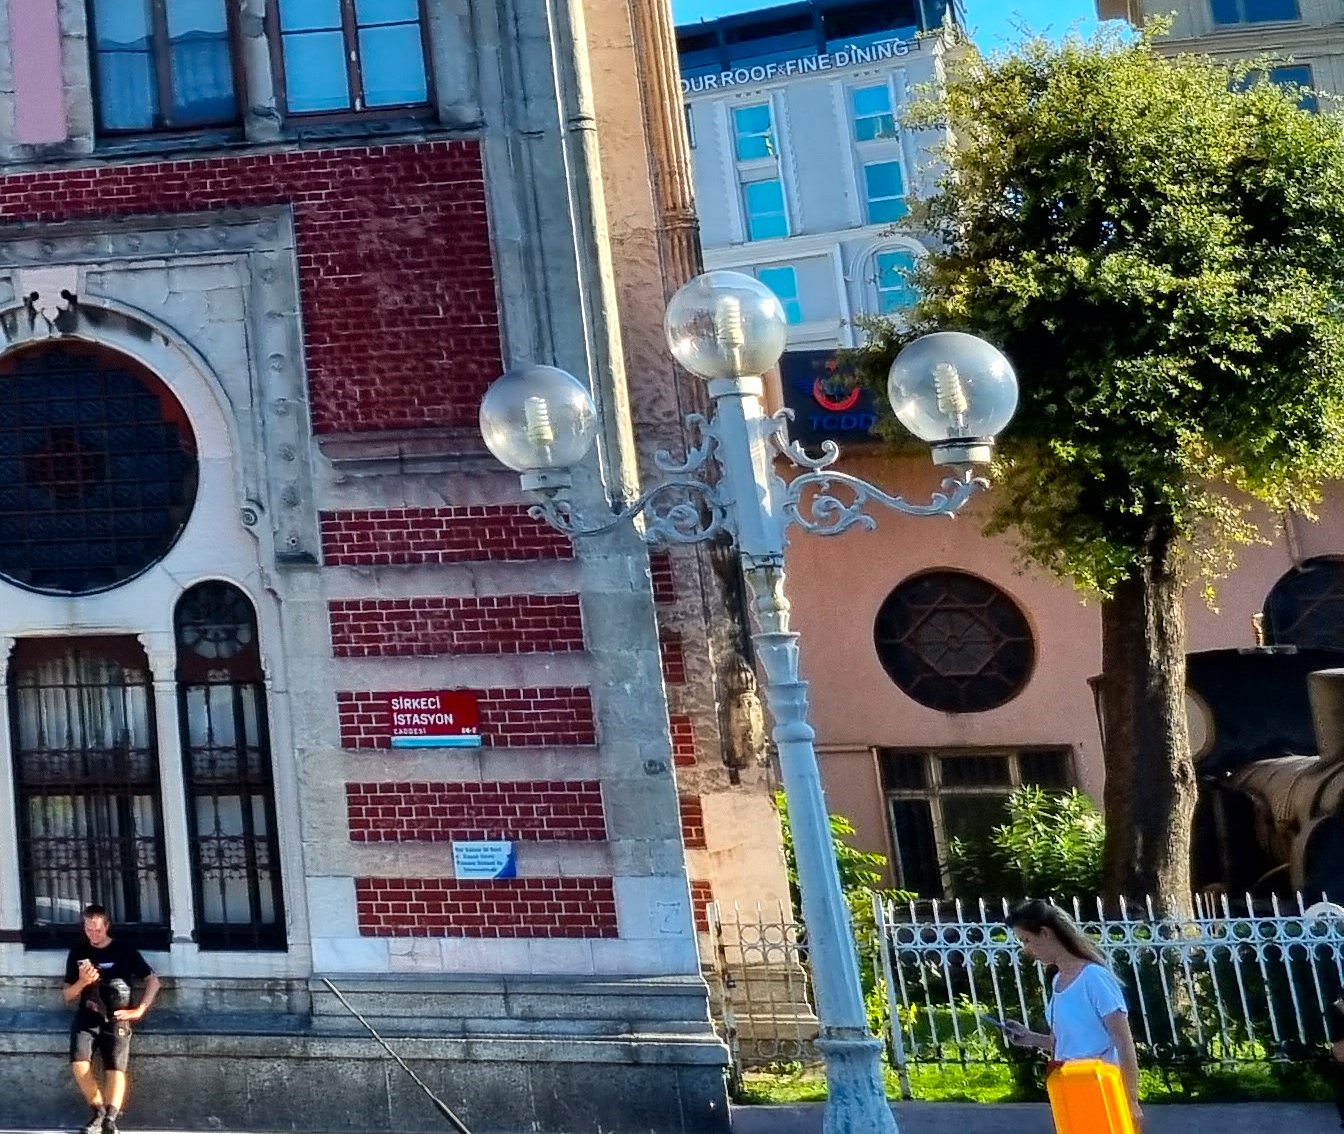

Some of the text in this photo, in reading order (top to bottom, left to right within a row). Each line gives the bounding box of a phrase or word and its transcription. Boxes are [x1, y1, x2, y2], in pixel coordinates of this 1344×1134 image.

[835, 40, 909, 66] DINING
[391, 695, 440, 710] SİRKECİ
[393, 712, 454, 725] İSTASYON
